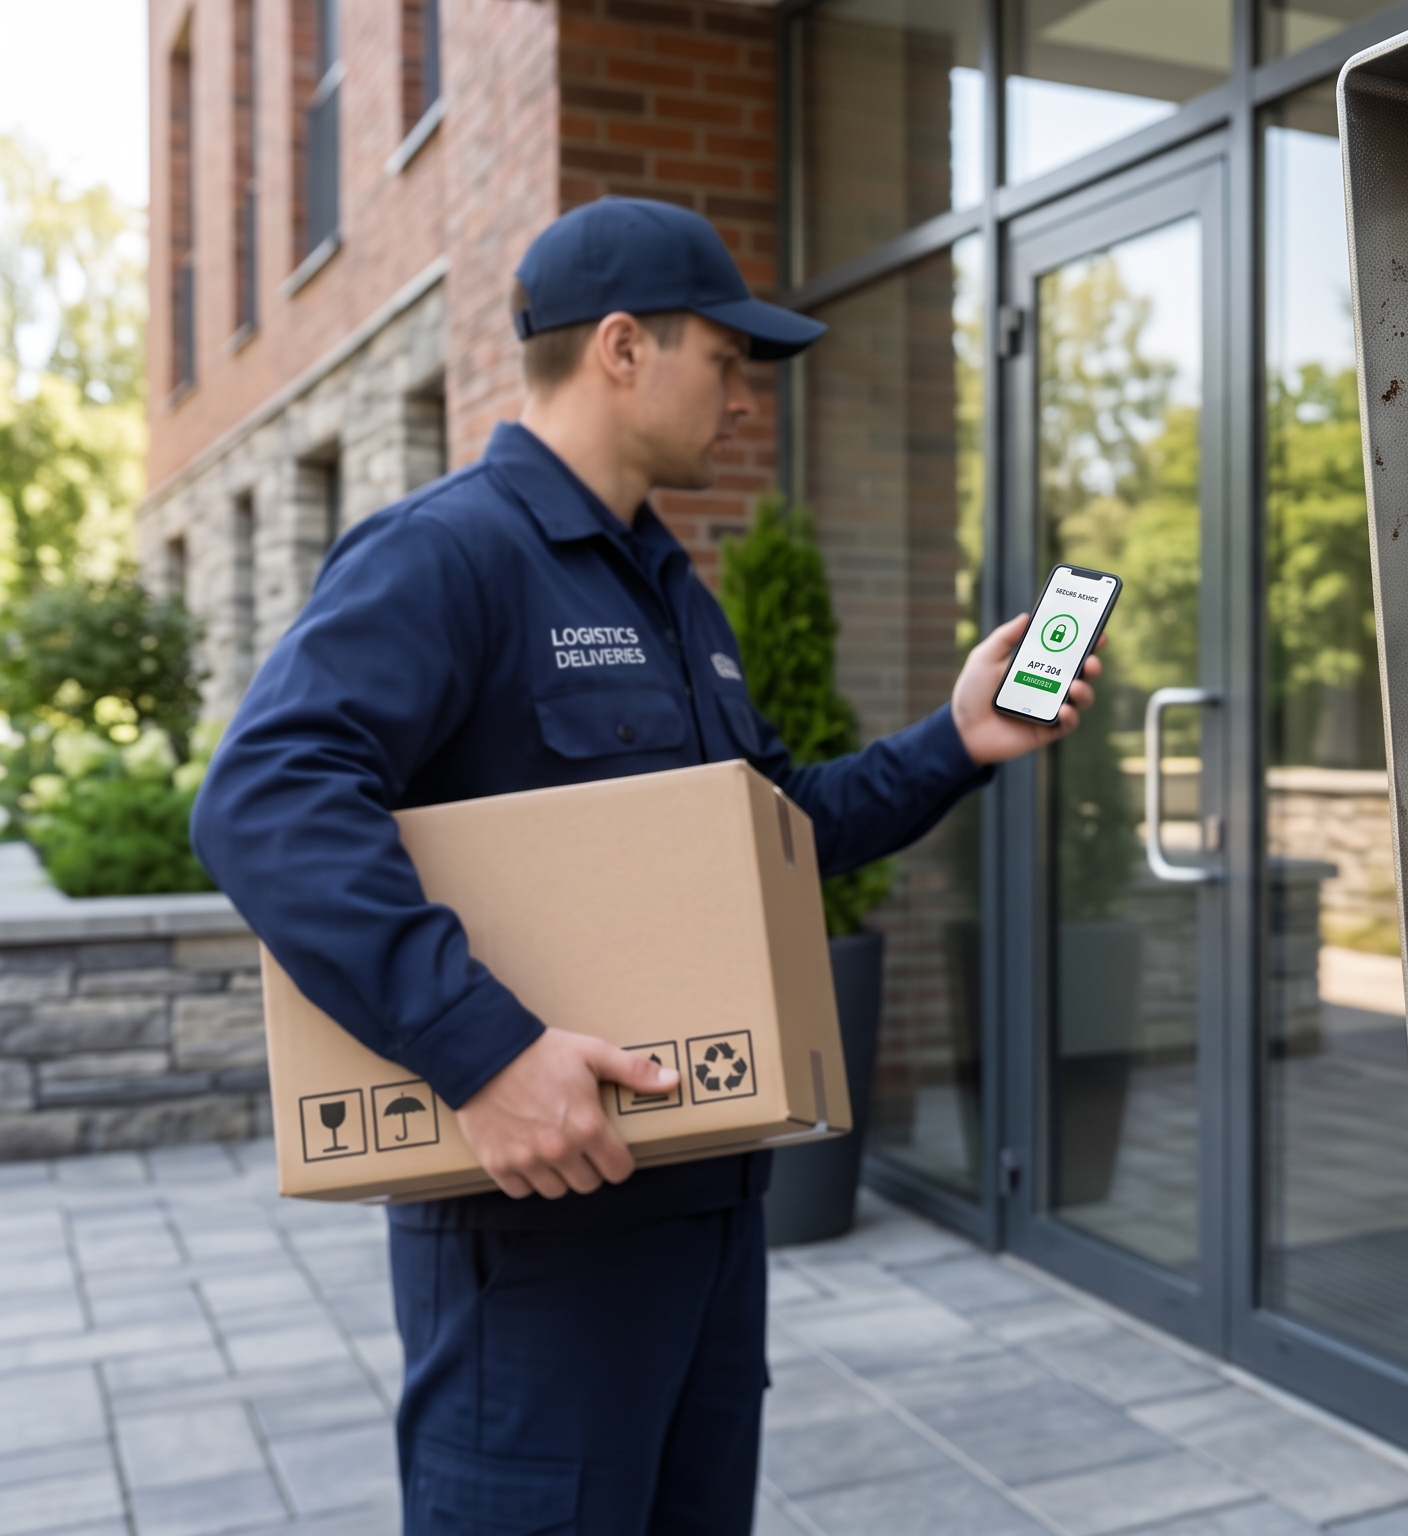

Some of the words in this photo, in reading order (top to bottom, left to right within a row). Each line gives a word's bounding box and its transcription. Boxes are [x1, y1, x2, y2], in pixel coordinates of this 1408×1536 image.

[551, 627, 639, 646] LOGISTICS
[556, 648, 646, 669] DELIVERIES
[1027, 660, 1045, 671] APT
